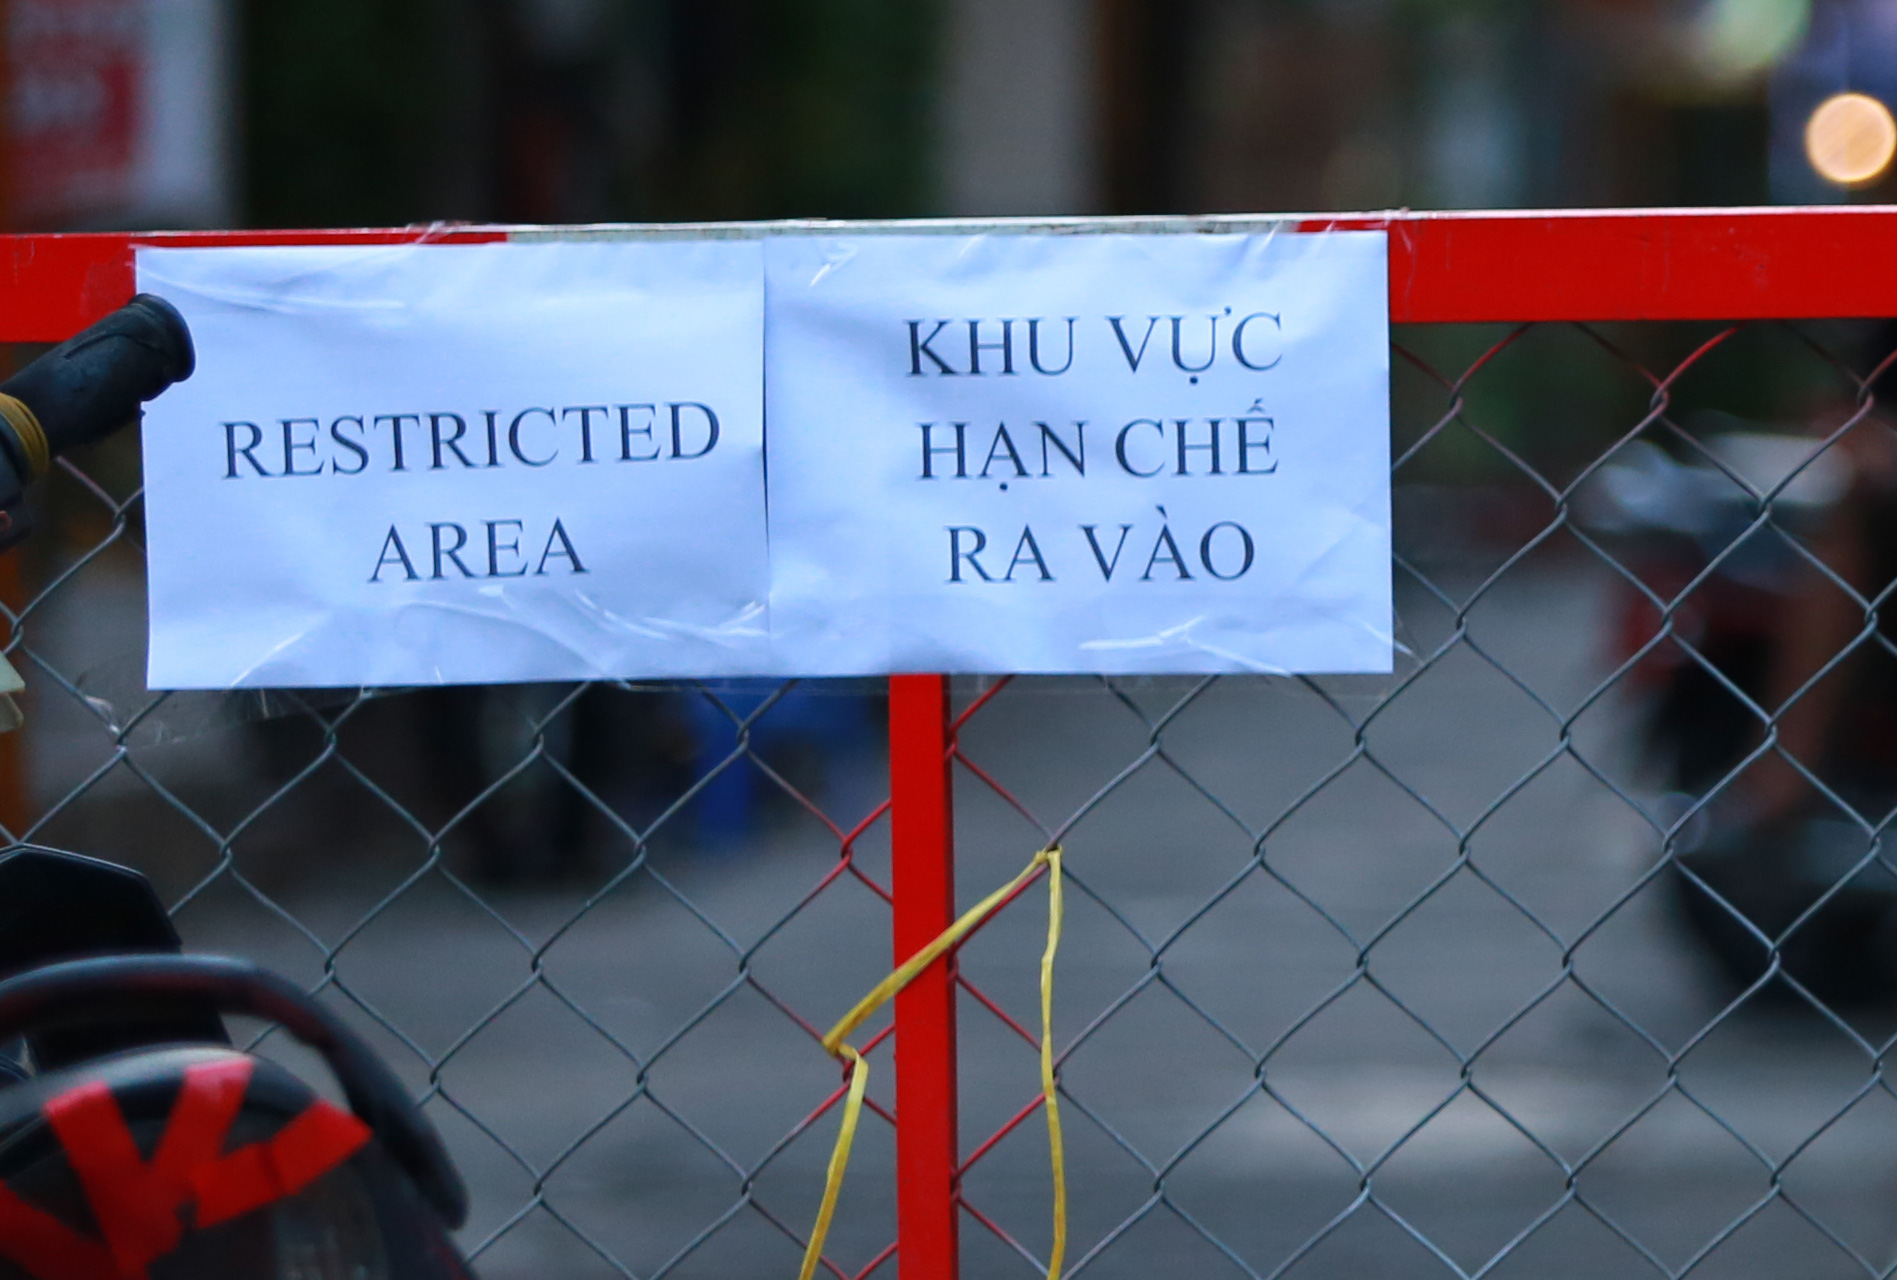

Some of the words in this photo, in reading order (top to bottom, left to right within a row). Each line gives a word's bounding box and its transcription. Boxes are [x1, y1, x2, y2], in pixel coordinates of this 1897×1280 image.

[906, 315, 1080, 377] KHU
[1104, 305, 1283, 385] VỰC
[221, 401, 721, 480] RESTRICTED
[917, 420, 1090, 491] HẠN
[1115, 397, 1280, 478] CHẾ
[366, 516, 591, 583] AREA
[944, 523, 1056, 584] RA
[1078, 504, 1256, 584] VÀO
